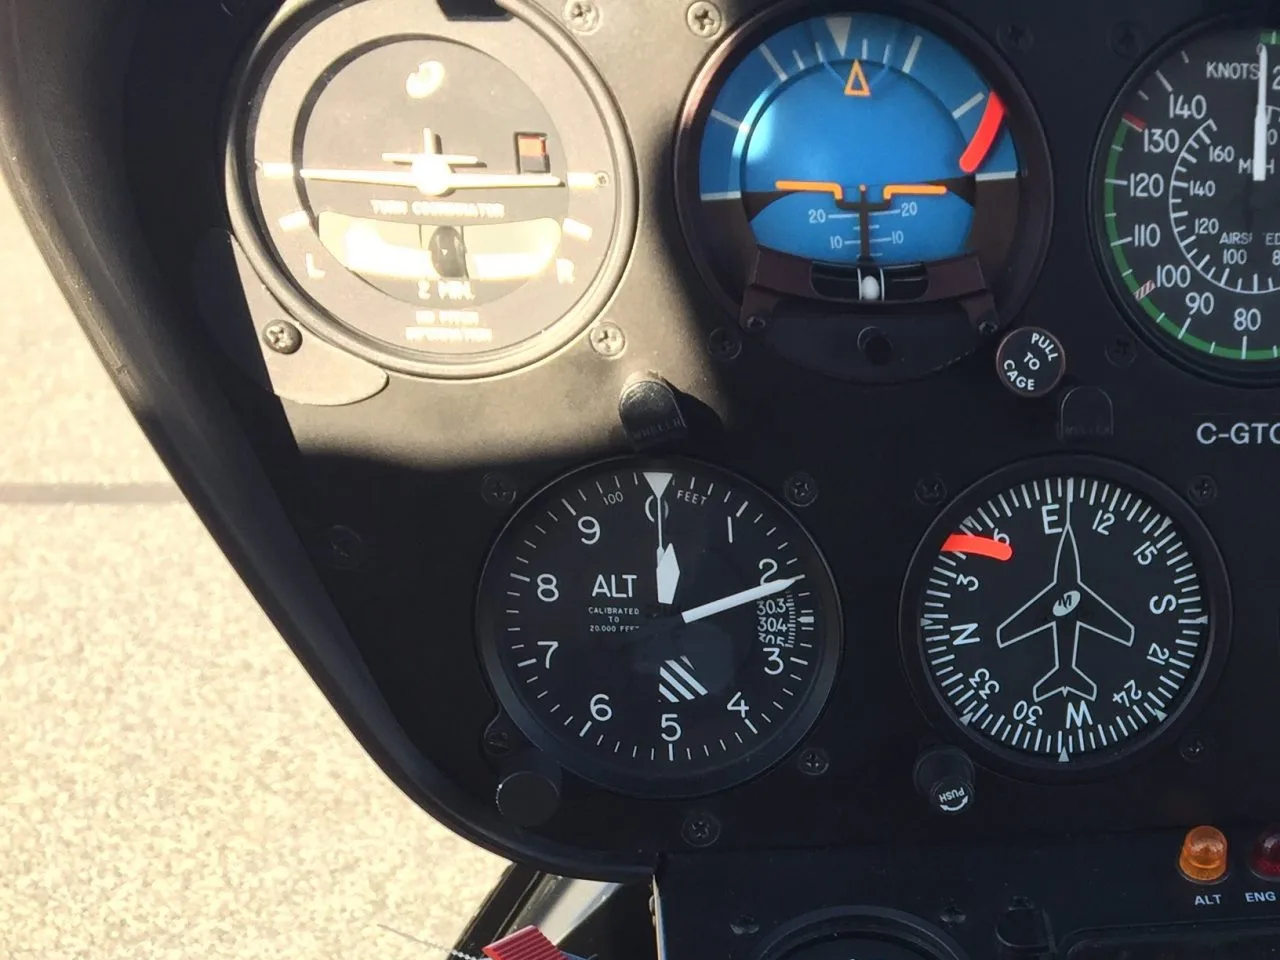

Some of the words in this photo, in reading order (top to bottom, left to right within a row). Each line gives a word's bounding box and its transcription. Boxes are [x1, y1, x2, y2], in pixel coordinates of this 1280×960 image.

[1206, 61, 1261, 80] KNOTS
[1169, 94, 1207, 119] 140
[1143, 128, 1180, 153] 130
[1208, 146, 1235, 163] 160
[1129, 172, 1164, 197] 120
[1189, 180, 1216, 197] 140
[808, 209, 827, 224] 20
[901, 202, 918, 217] 20
[1134, 223, 1160, 247] 110
[1195, 218, 1219, 234] 120
[1223, 248, 1248, 265] 100
[1156, 264, 1191, 288] 100
[1185, 292, 1215, 315] 90
[1233, 308, 1261, 331] 80
[1030, 332, 1059, 362] PULL
[1023, 352, 1041, 371] TO
[1003, 359, 1036, 391] CAGE
[676, 490, 707, 505] FEET
[577, 516, 601, 545] 9
[1042, 504, 1063, 535] E
[1092, 509, 1116, 535] 12
[1133, 540, 1159, 566] 15
[536, 573, 560, 602] 8
[591, 574, 638, 598] ALT
[588, 606, 640, 615] CALIBRATED
[1149, 593, 1177, 615] S
[537, 641, 559, 668] 7
[762, 647, 784, 675] 3
[968, 667, 1000, 700] 33
[1112, 679, 1143, 708] 24
[589, 693, 612, 722] 6
[726, 691, 750, 718] 4
[1013, 700, 1043, 727] 30
[661, 713, 682, 741] 5
[938, 784, 966, 803] PUSH
[1194, 894, 1222, 906] ALT
[1245, 891, 1276, 903] ENG
